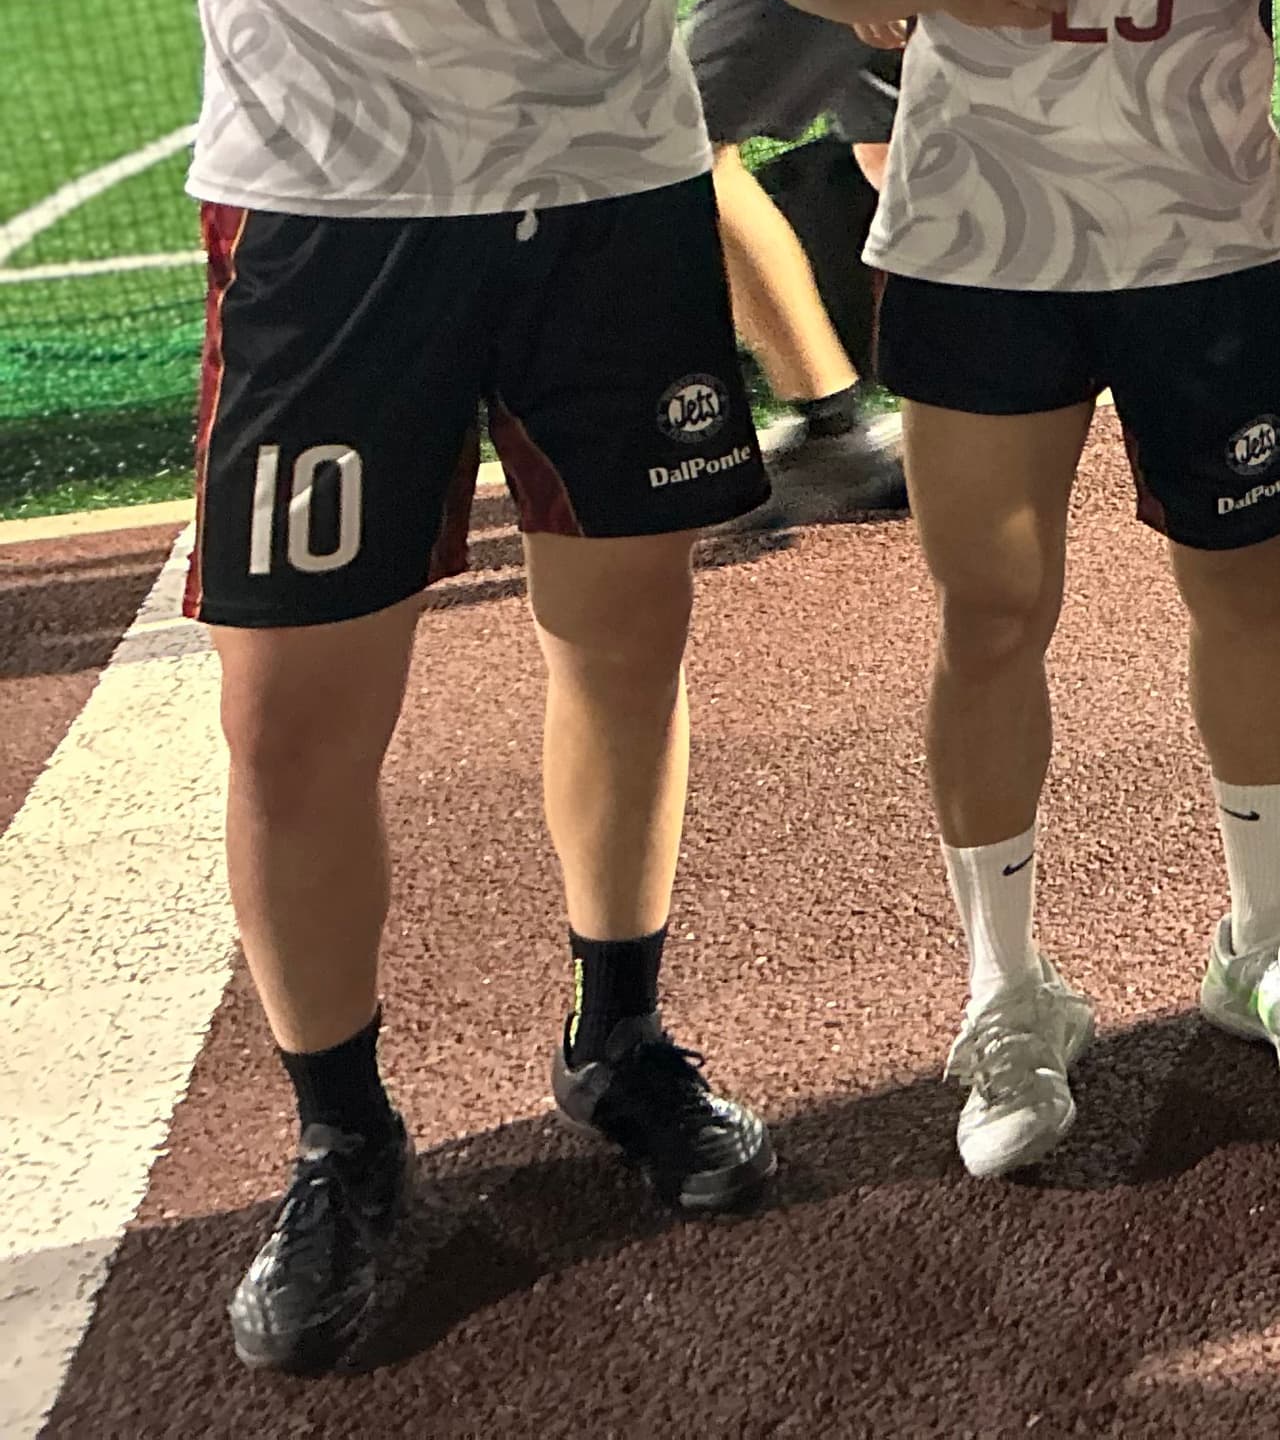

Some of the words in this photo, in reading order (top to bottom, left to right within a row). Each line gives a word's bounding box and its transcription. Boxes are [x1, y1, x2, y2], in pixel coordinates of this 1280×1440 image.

[672, 389, 716, 428] Jets
[648, 445, 752, 489] DalPonte
[249, 443, 362, 574] 10
